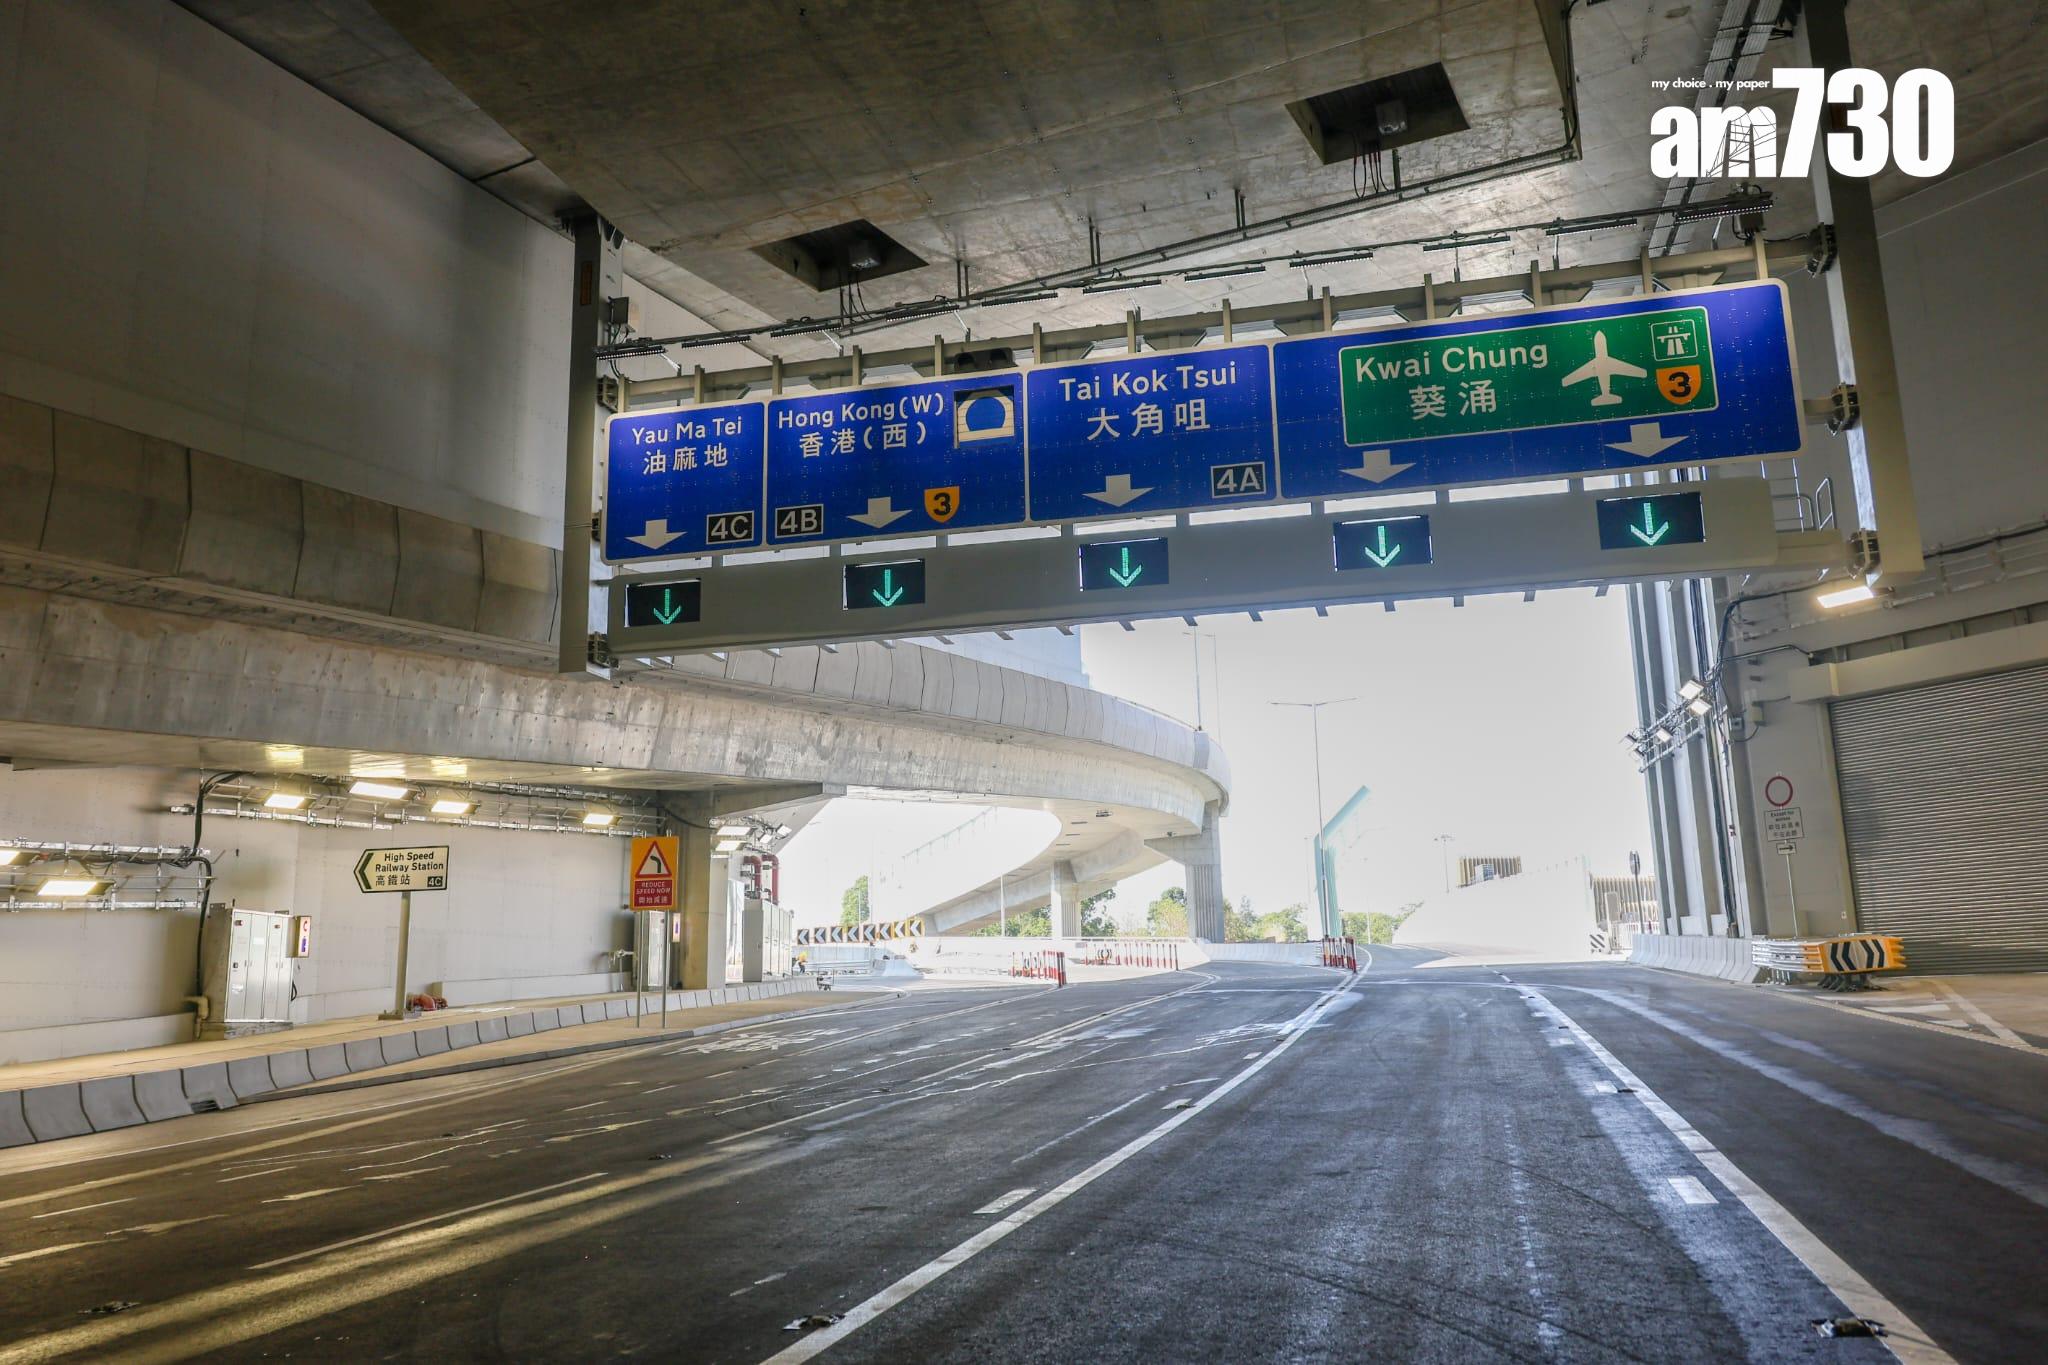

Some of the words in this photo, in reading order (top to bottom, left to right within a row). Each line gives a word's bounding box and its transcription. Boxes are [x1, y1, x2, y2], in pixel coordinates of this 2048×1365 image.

[1355, 349, 1431, 383] Kwai
[1441, 344, 1548, 372] Chung
[1059, 375, 1101, 402] Tai
[1112, 368, 1168, 397] Kok
[1175, 360, 1237, 390] Tsui
[1668, 371, 1692, 398] 3
[1408, 379, 1499, 421] 葵涌
[632, 426, 668, 445] Yau
[676, 421, 706, 441] Ma
[712, 415, 742, 437] Tei
[778, 409, 834, 429] Hong
[1086, 398, 1211, 442] 大角咀
[642, 442, 728, 476] 油麻地
[1216, 465, 1262, 494] 4A
[933, 492, 952, 517] 3
[710, 514, 749, 540] 4C
[779, 507, 819, 534] 4B
[375, 863, 409, 872] Railway
[411, 862, 444, 871] Station
[384, 853, 405, 862] High
[406, 851, 434, 861] Speed
[427, 877, 443, 887] 4C
